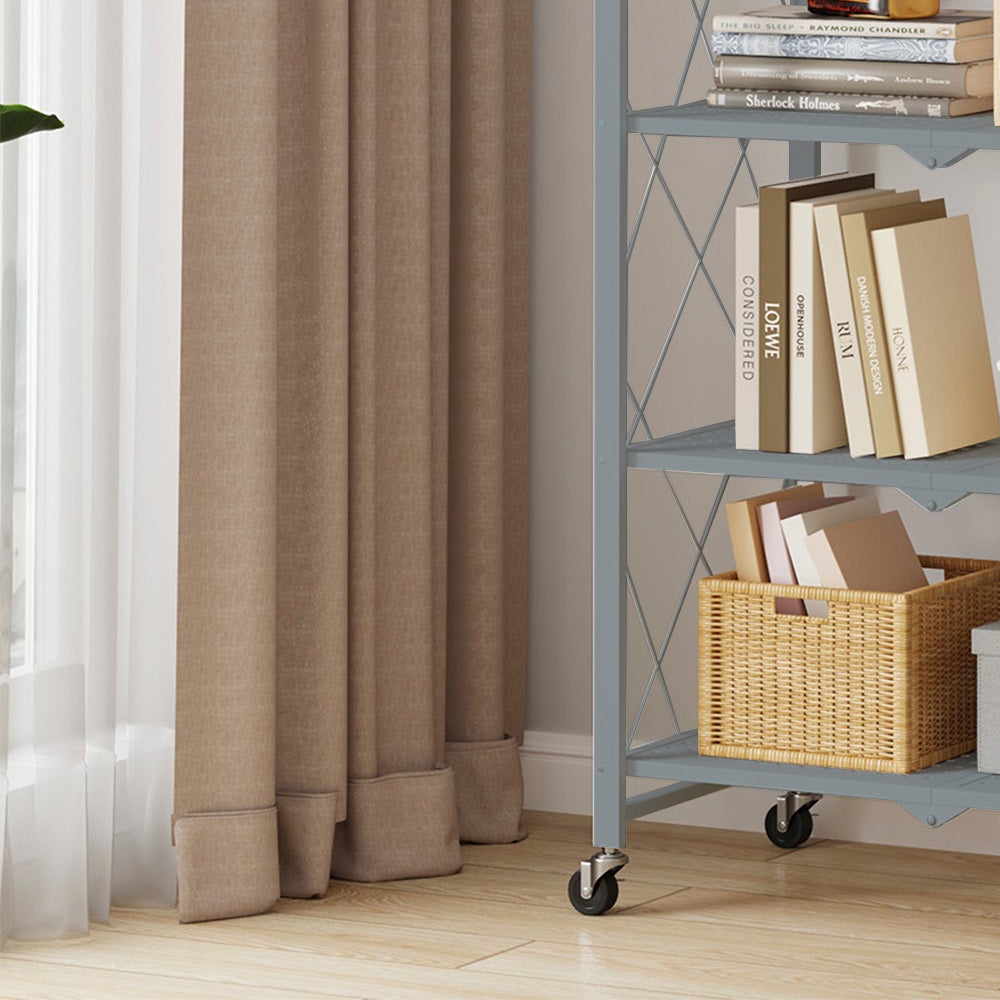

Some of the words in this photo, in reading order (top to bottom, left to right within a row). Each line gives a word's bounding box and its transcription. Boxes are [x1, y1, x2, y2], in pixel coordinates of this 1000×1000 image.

[809, 24, 865, 34] RAYMOND
[869, 26, 926, 34] CHANDLER
[894, 75, 923, 84] Andrew
[745, 93, 796, 109] Sherlock
[799, 95, 841, 111] Holmes
[856, 276, 870, 313] DANISH
[742, 275, 755, 381] CONSIDERED
[764, 302, 780, 359] LOEWE
[796, 294, 805, 358] OPENHOUSE
[837, 321, 854, 359] RUM
[862, 314, 876, 357] MODERN
[869, 359, 883, 395] DESIGN
